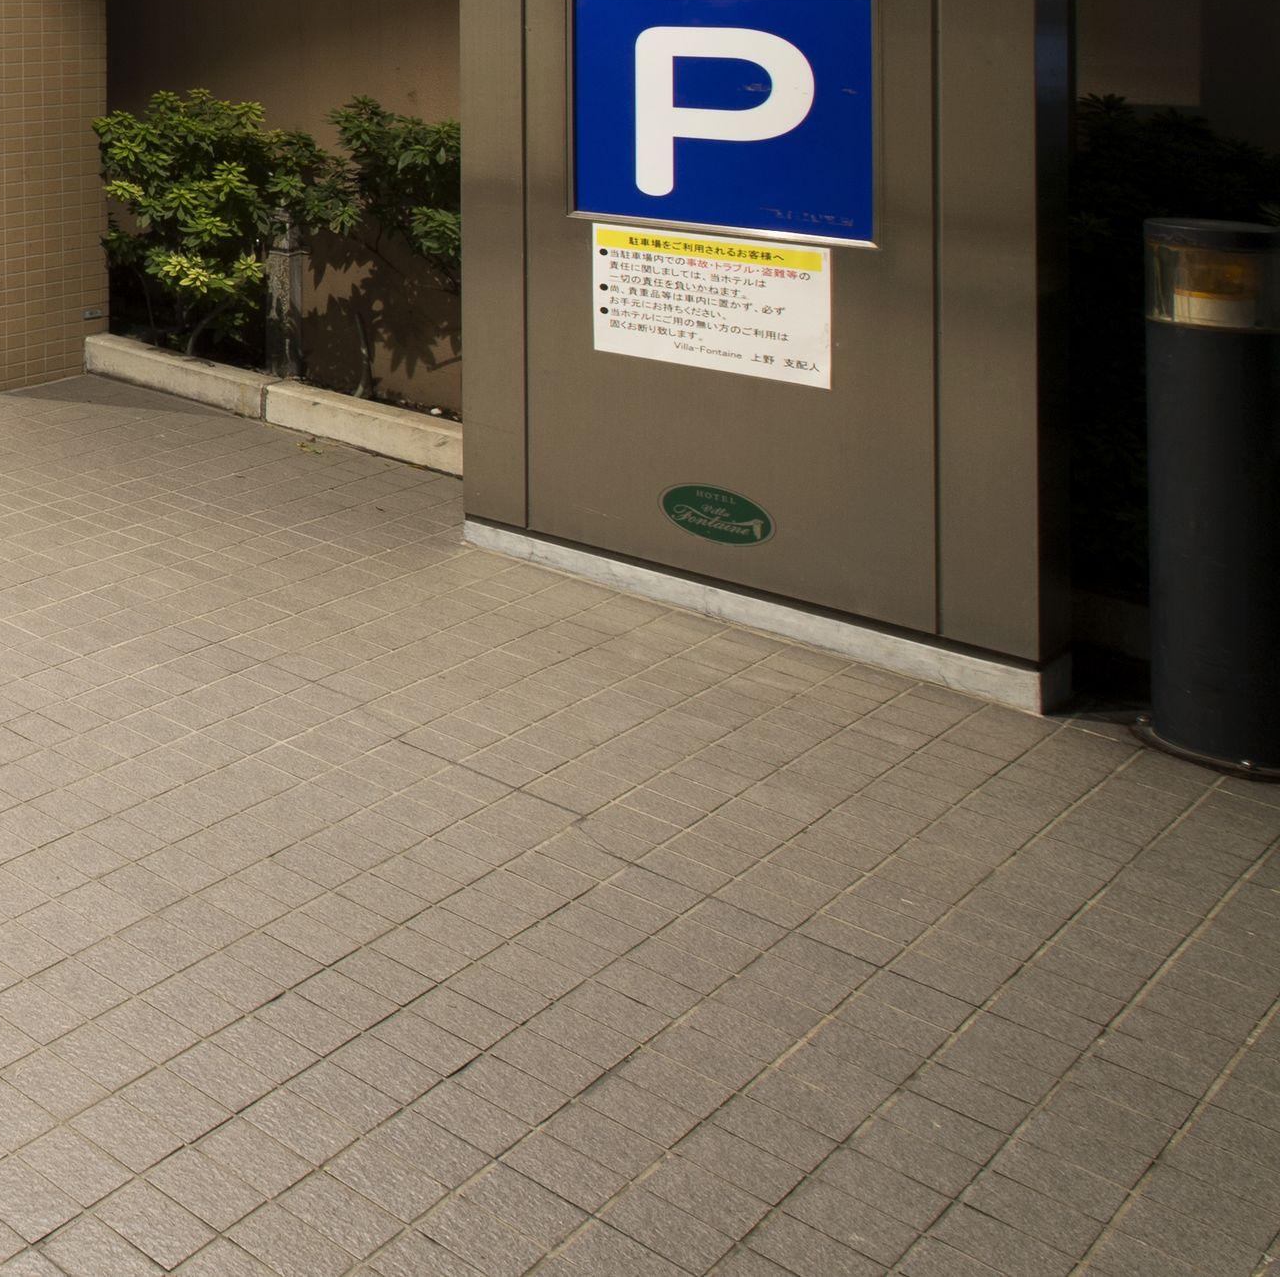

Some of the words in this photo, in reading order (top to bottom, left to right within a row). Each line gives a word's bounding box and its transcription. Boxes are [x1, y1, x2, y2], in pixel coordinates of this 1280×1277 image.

[635, 26, 815, 197] P
[628, 236, 785, 262] 駐車場をご利用されるお客様へ
[609, 260, 767, 289] 責任に関しましては、当ホテルは
[609, 274, 748, 299] 一切の責任を負いかねます。
[609, 283, 787, 316] 尚、貴重品等は車内に置かず、必ず
[609, 295, 727, 320] お手元にお持ちください。
[609, 319, 703, 341] 固くお断り致します。
[610, 308, 789, 342] 当ホテルにご用の無い方のご利用は
[673, 340, 743, 360] Villa-Fontaine
[750, 351, 775, 366] 上野
[783, 357, 821, 373] 支配人
[695, 489, 737, 505] HOTEL
[671, 506, 751, 536] Fontaine
[701, 504, 731, 518] Villa
